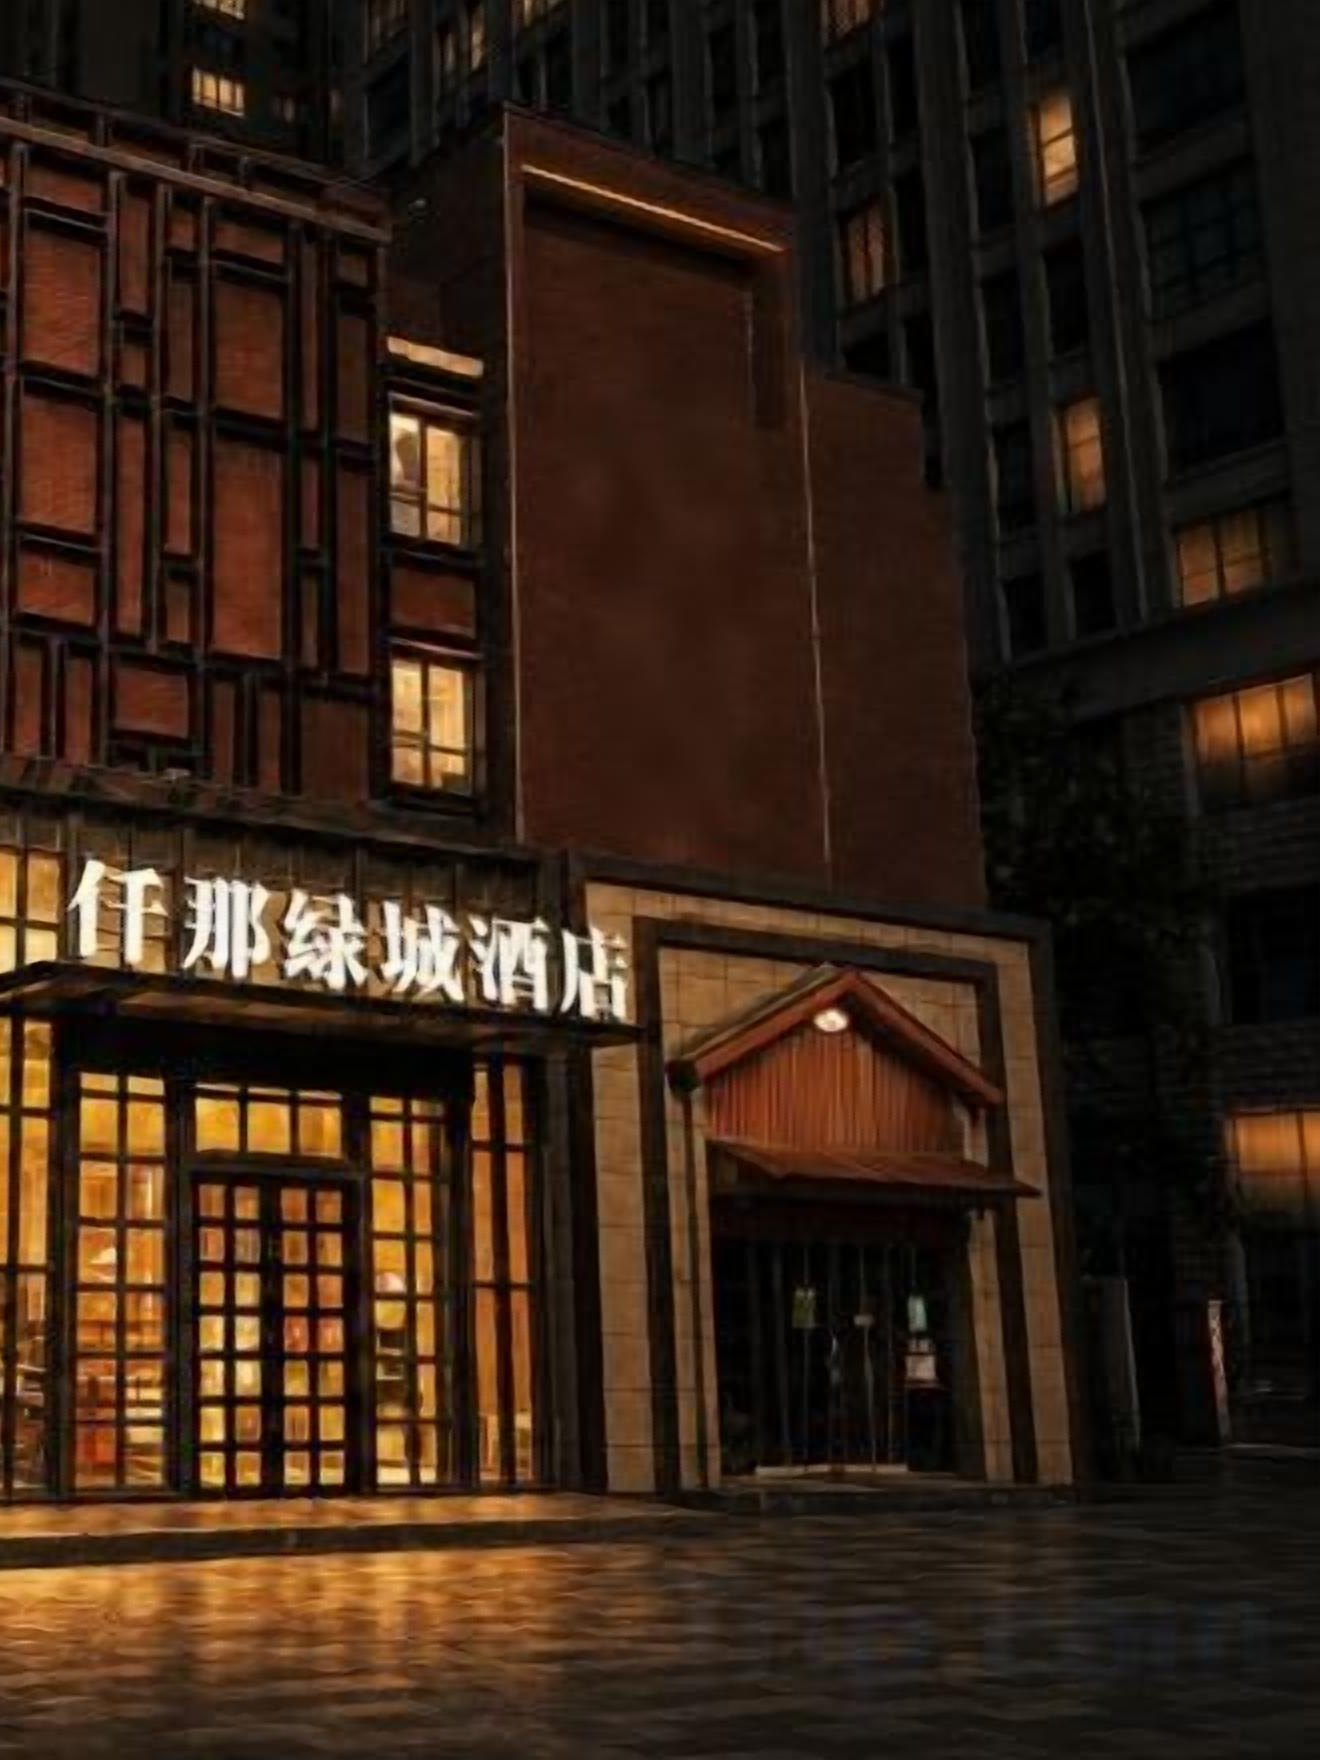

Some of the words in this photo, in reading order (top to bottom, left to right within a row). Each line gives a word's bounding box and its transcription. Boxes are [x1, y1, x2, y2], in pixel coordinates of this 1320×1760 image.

[67, 860, 628, 1022] 仟那绿城酒店
